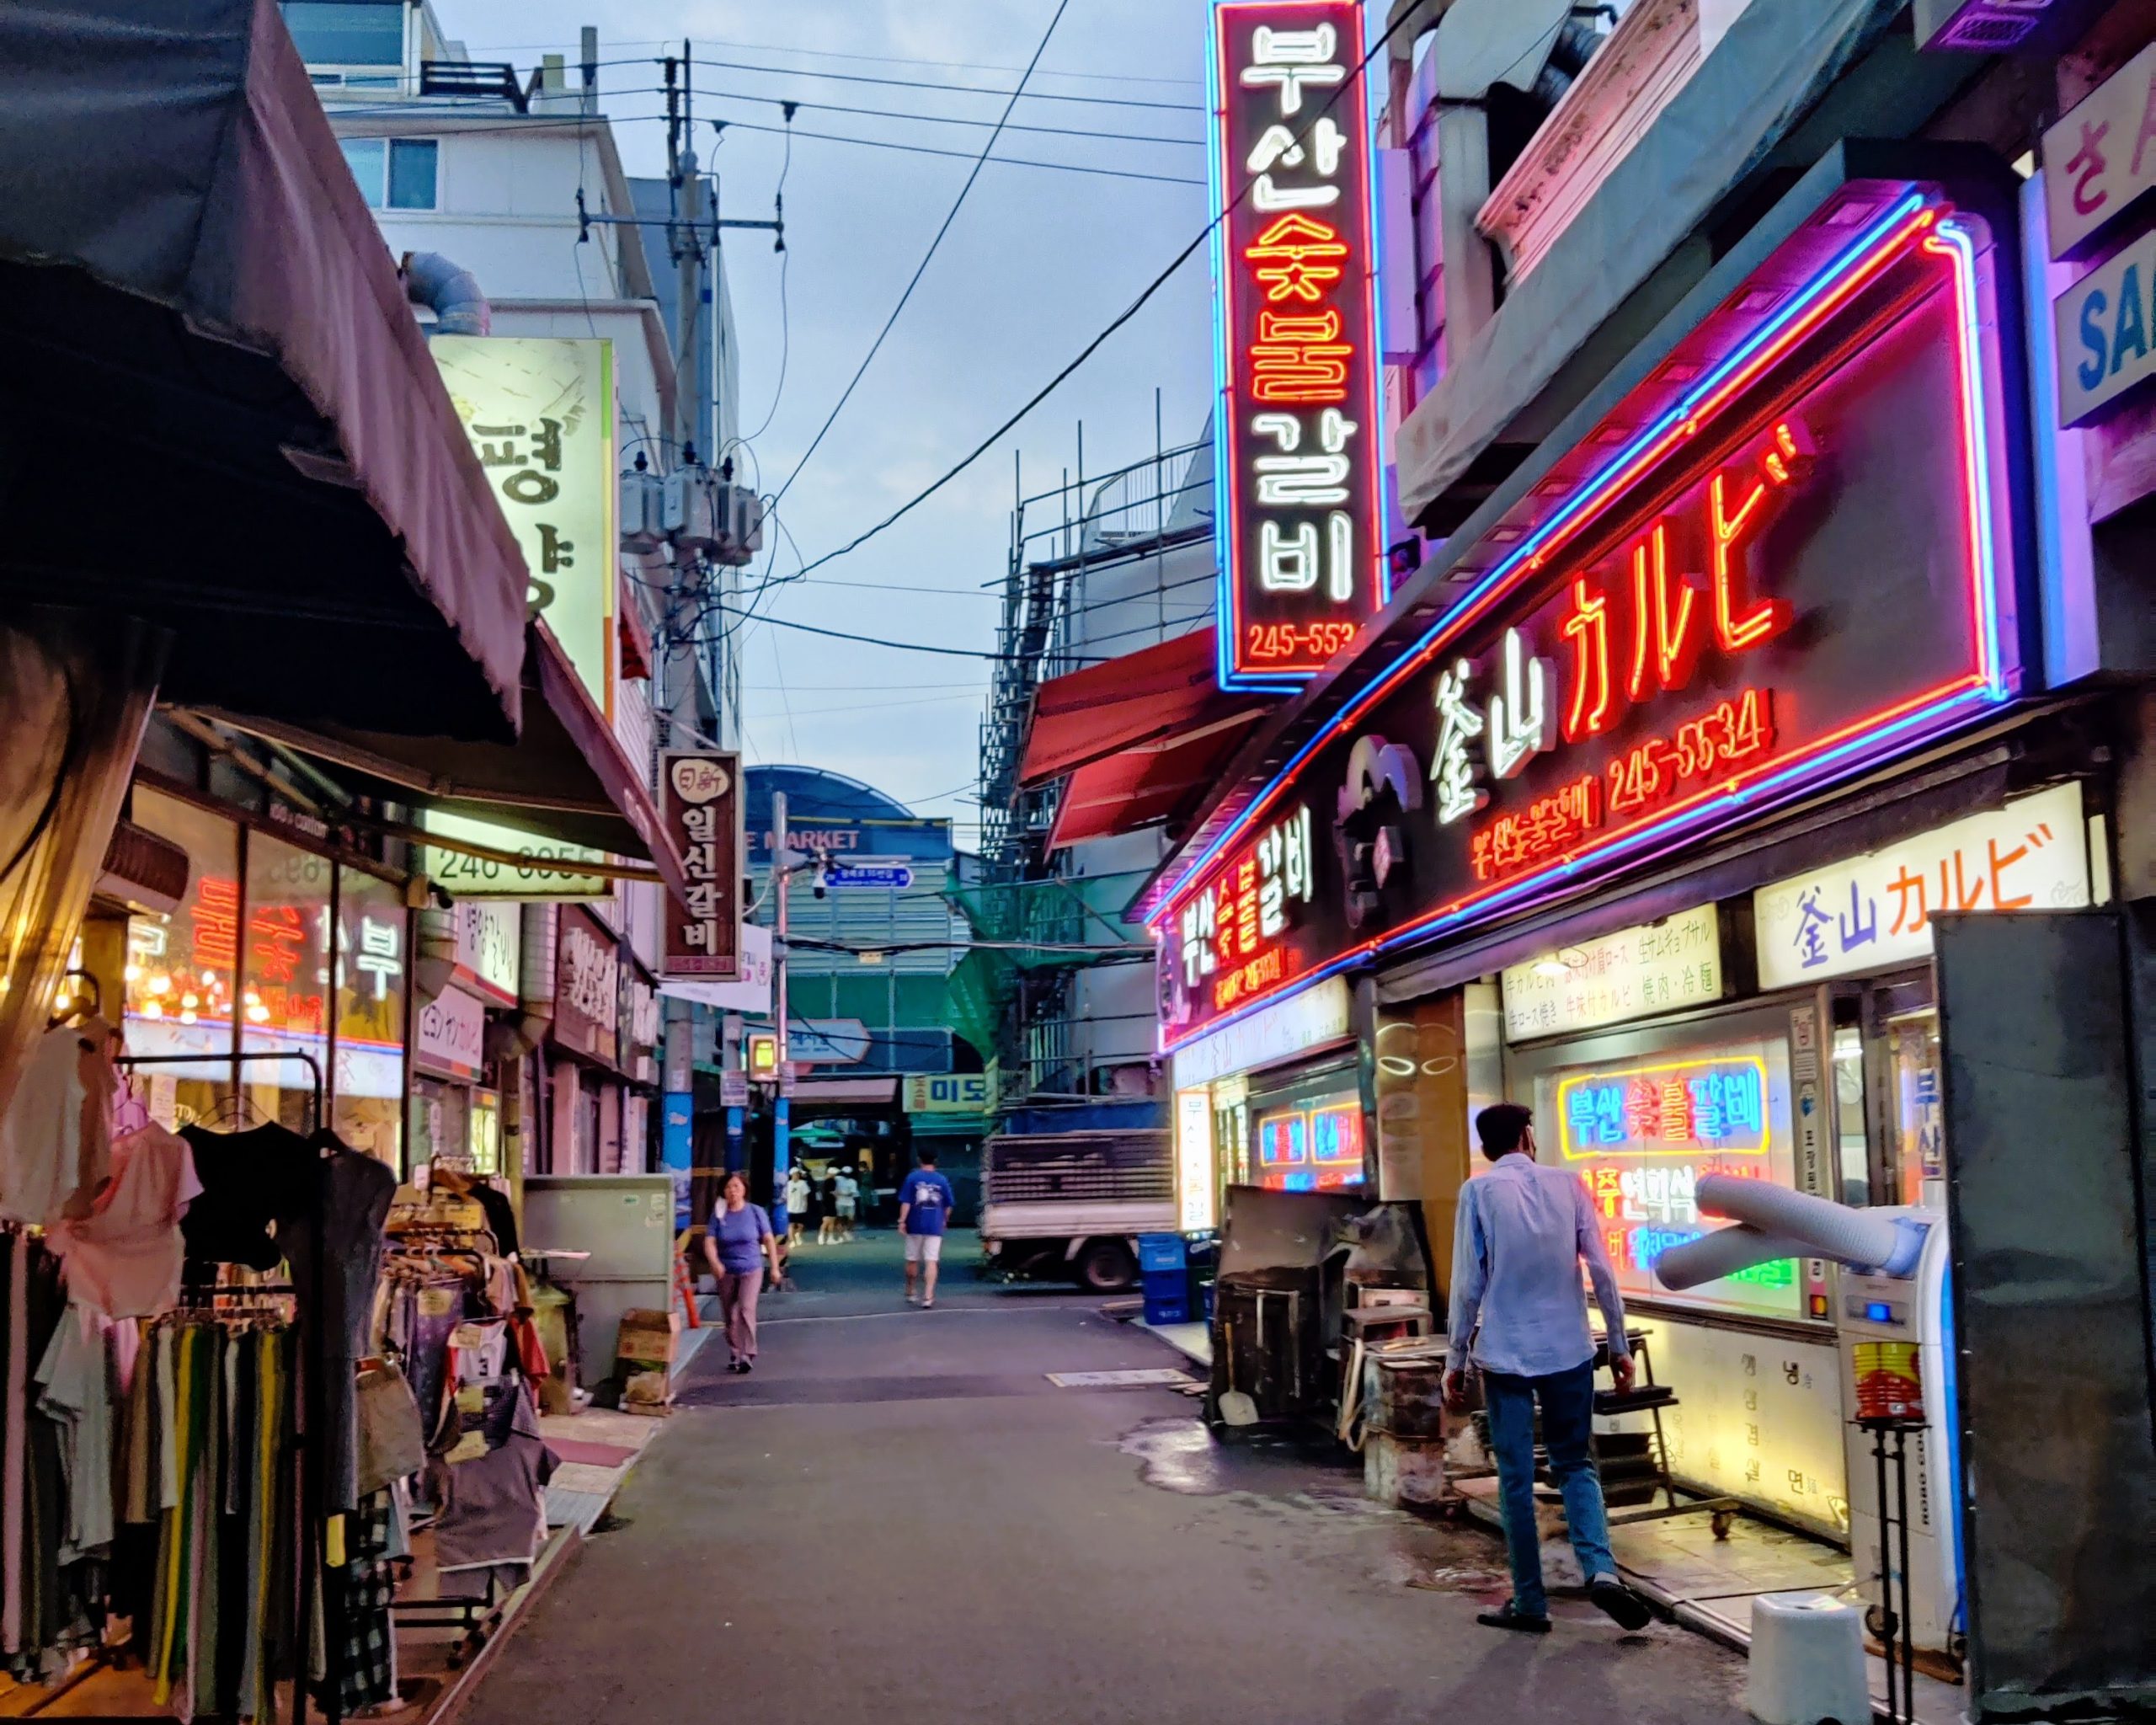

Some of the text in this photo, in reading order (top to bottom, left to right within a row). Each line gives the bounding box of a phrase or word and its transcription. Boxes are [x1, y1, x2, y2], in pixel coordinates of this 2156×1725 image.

[1608, 688, 1768, 811] 245-5534
[680, 805, 725, 956] 일신갈비
[764, 830, 860, 850] MARKET
[1791, 821, 2054, 969] 釜山カルビ
[1569, 1066, 1759, 1147] 부산숯불갈비
